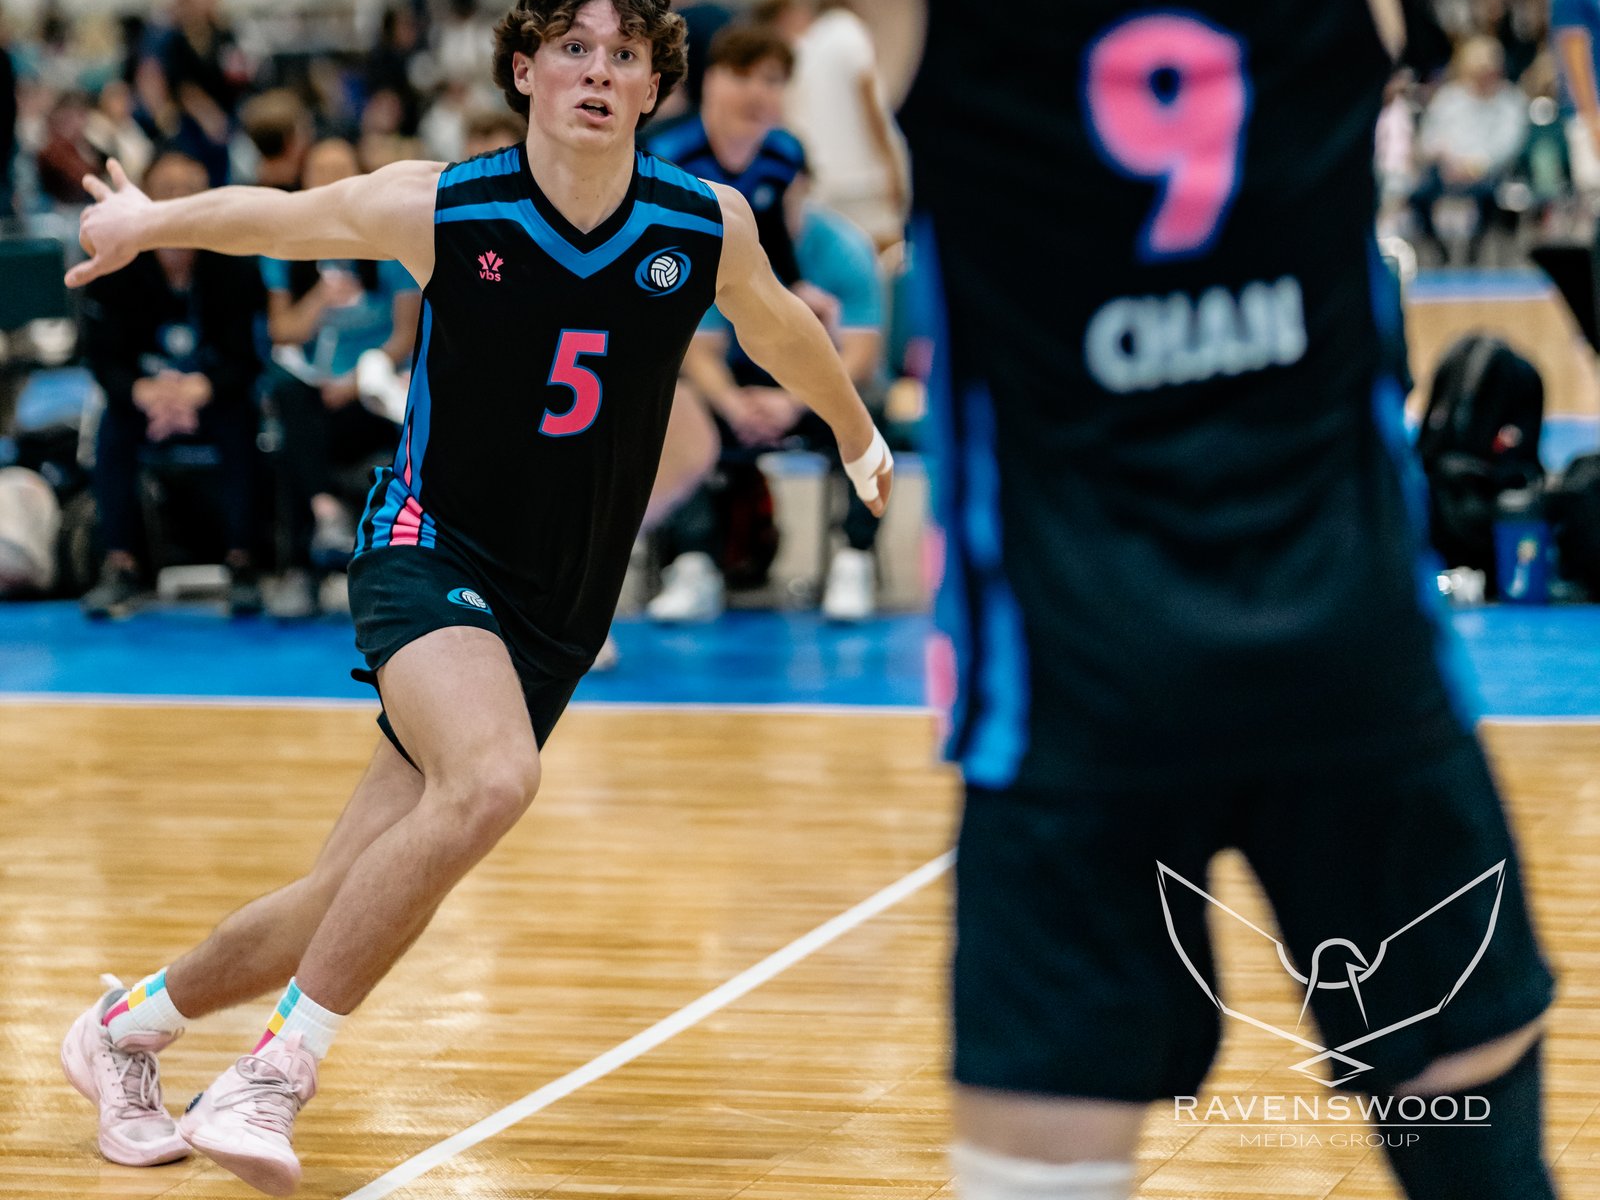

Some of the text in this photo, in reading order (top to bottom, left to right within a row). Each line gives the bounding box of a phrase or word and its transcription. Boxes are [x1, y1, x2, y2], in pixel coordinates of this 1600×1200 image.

[1084, 8, 1250, 261] 9
[479, 270, 502, 282] vbs
[538, 328, 609, 438] 5
[1084, 276, 1307, 393] CHAN
